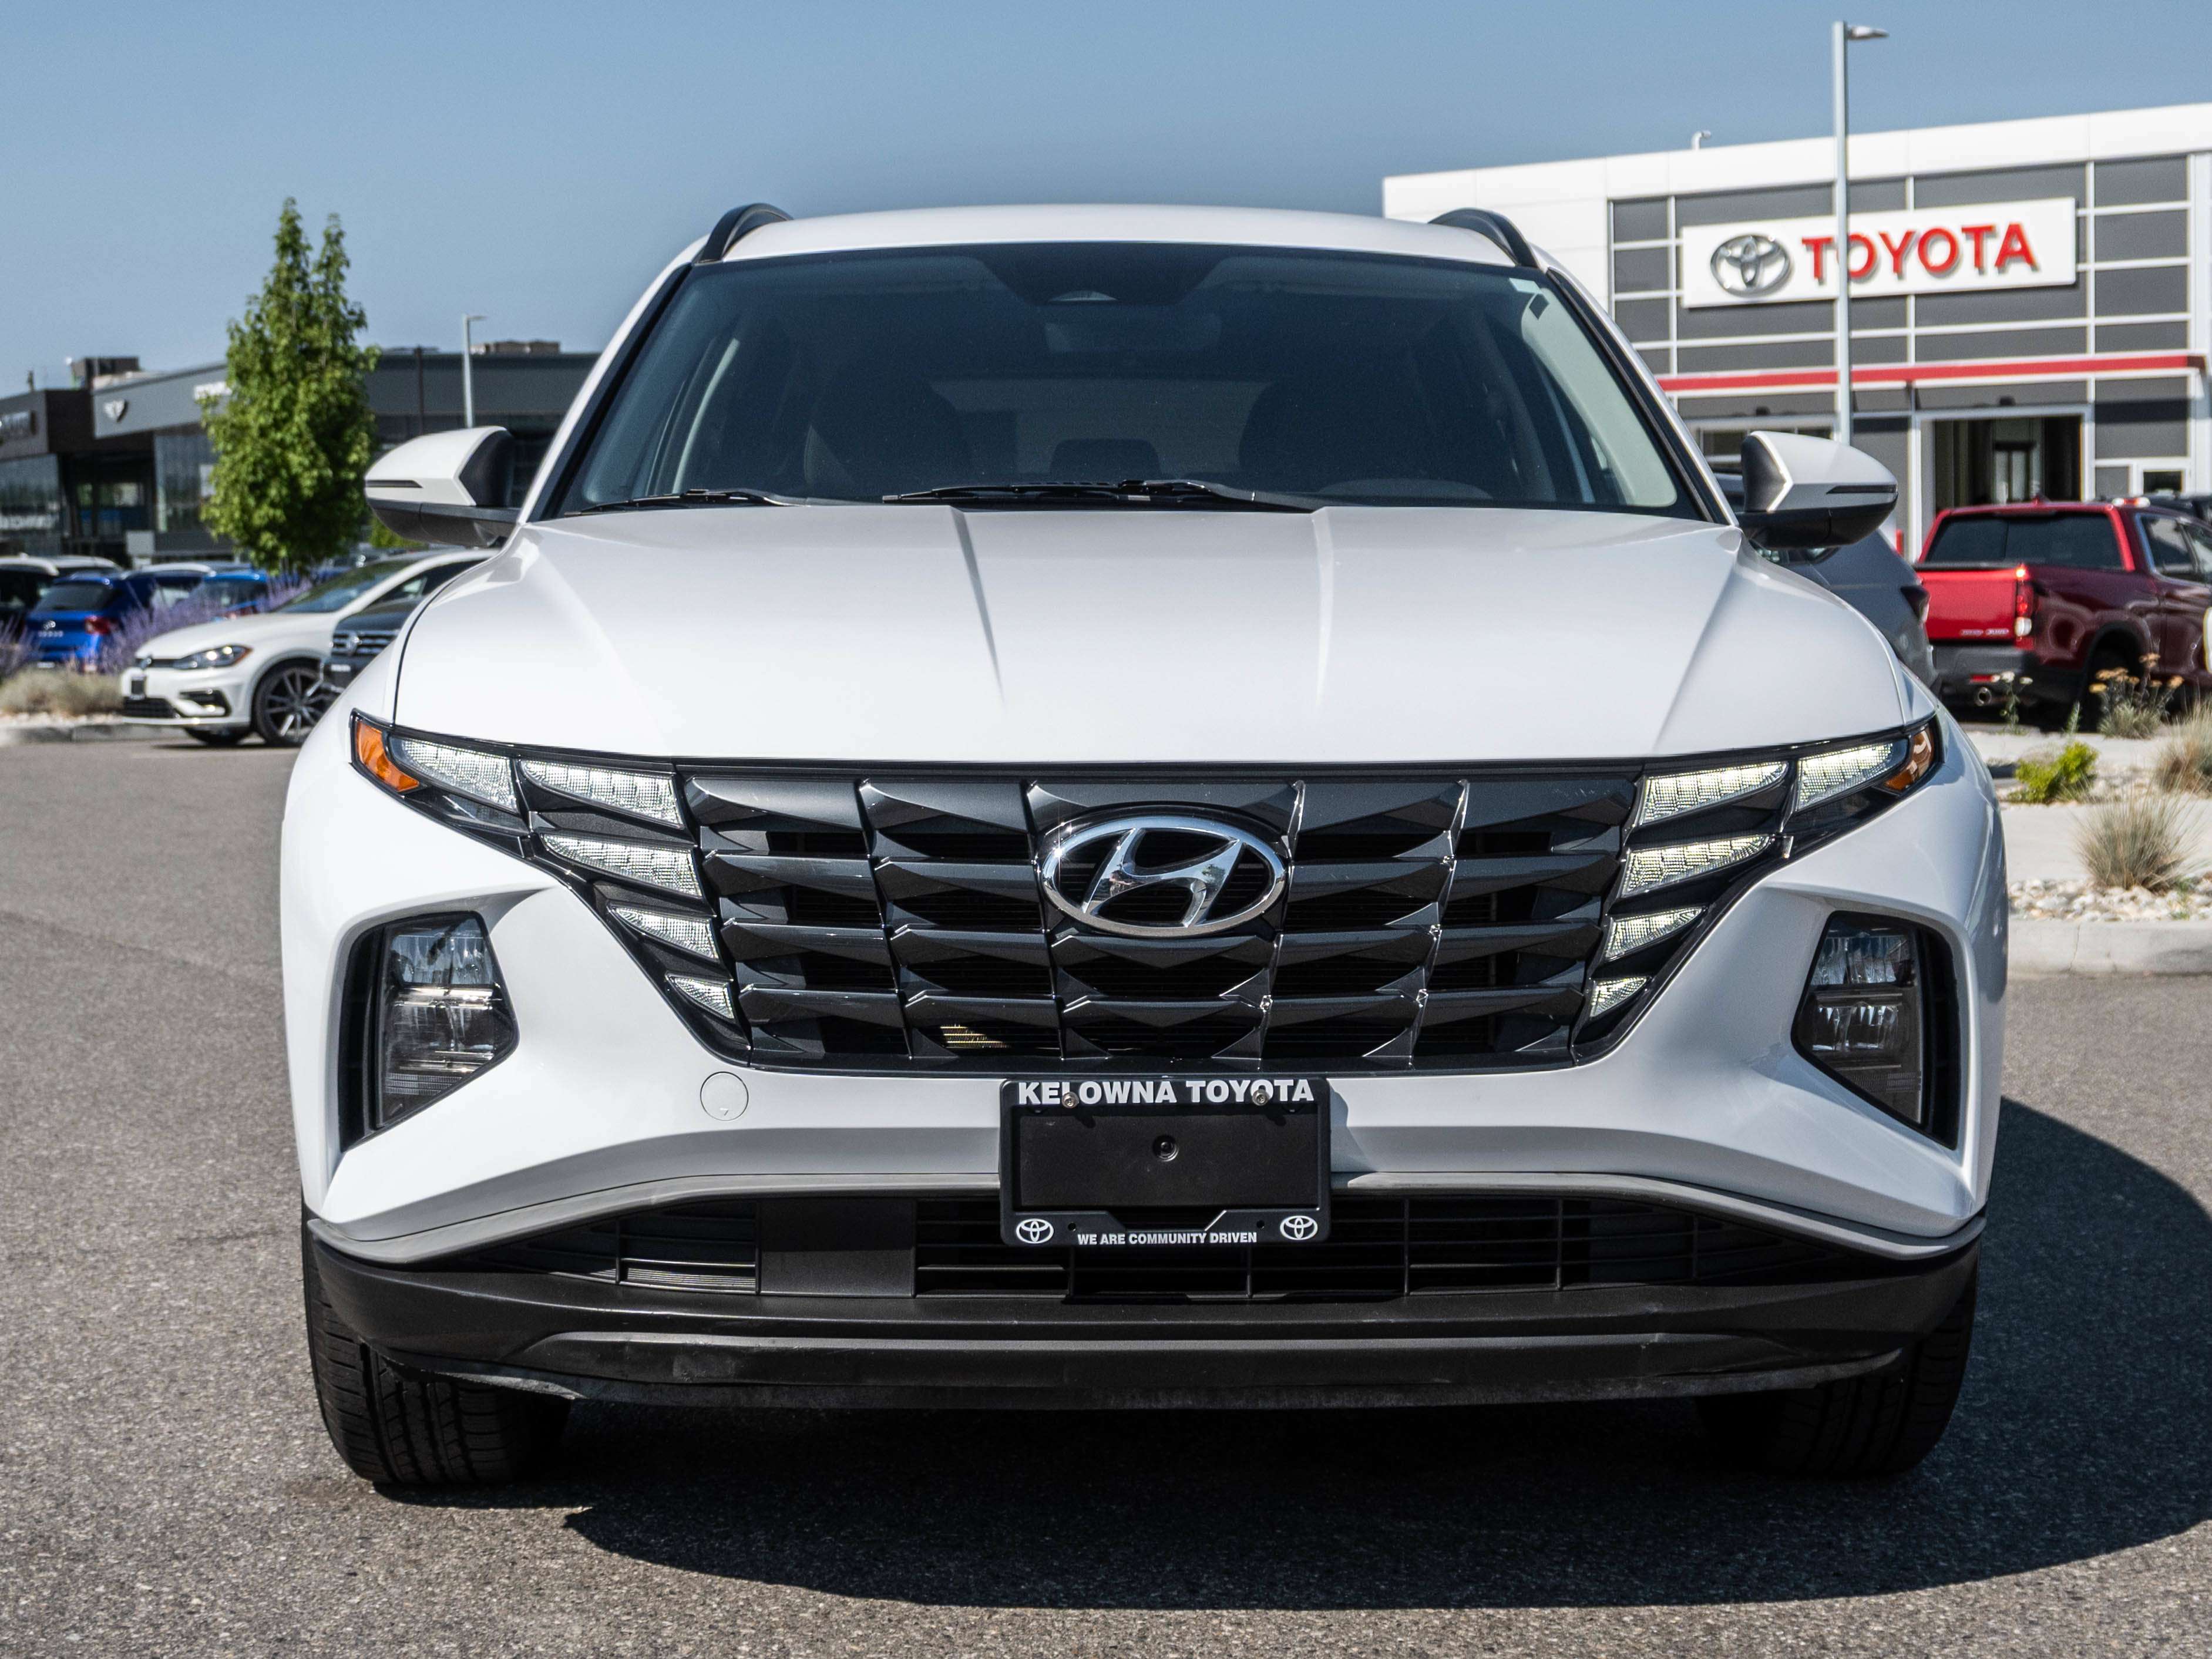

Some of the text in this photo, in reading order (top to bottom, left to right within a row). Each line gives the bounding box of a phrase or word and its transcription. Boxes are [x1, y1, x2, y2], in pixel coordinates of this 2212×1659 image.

[1801, 222, 2037, 280] TOYOTA
[1186, 1079, 1314, 1103] TOYOTA
[1077, 1231, 1257, 1245] WE ARE COMMUNITY DRIVEN
